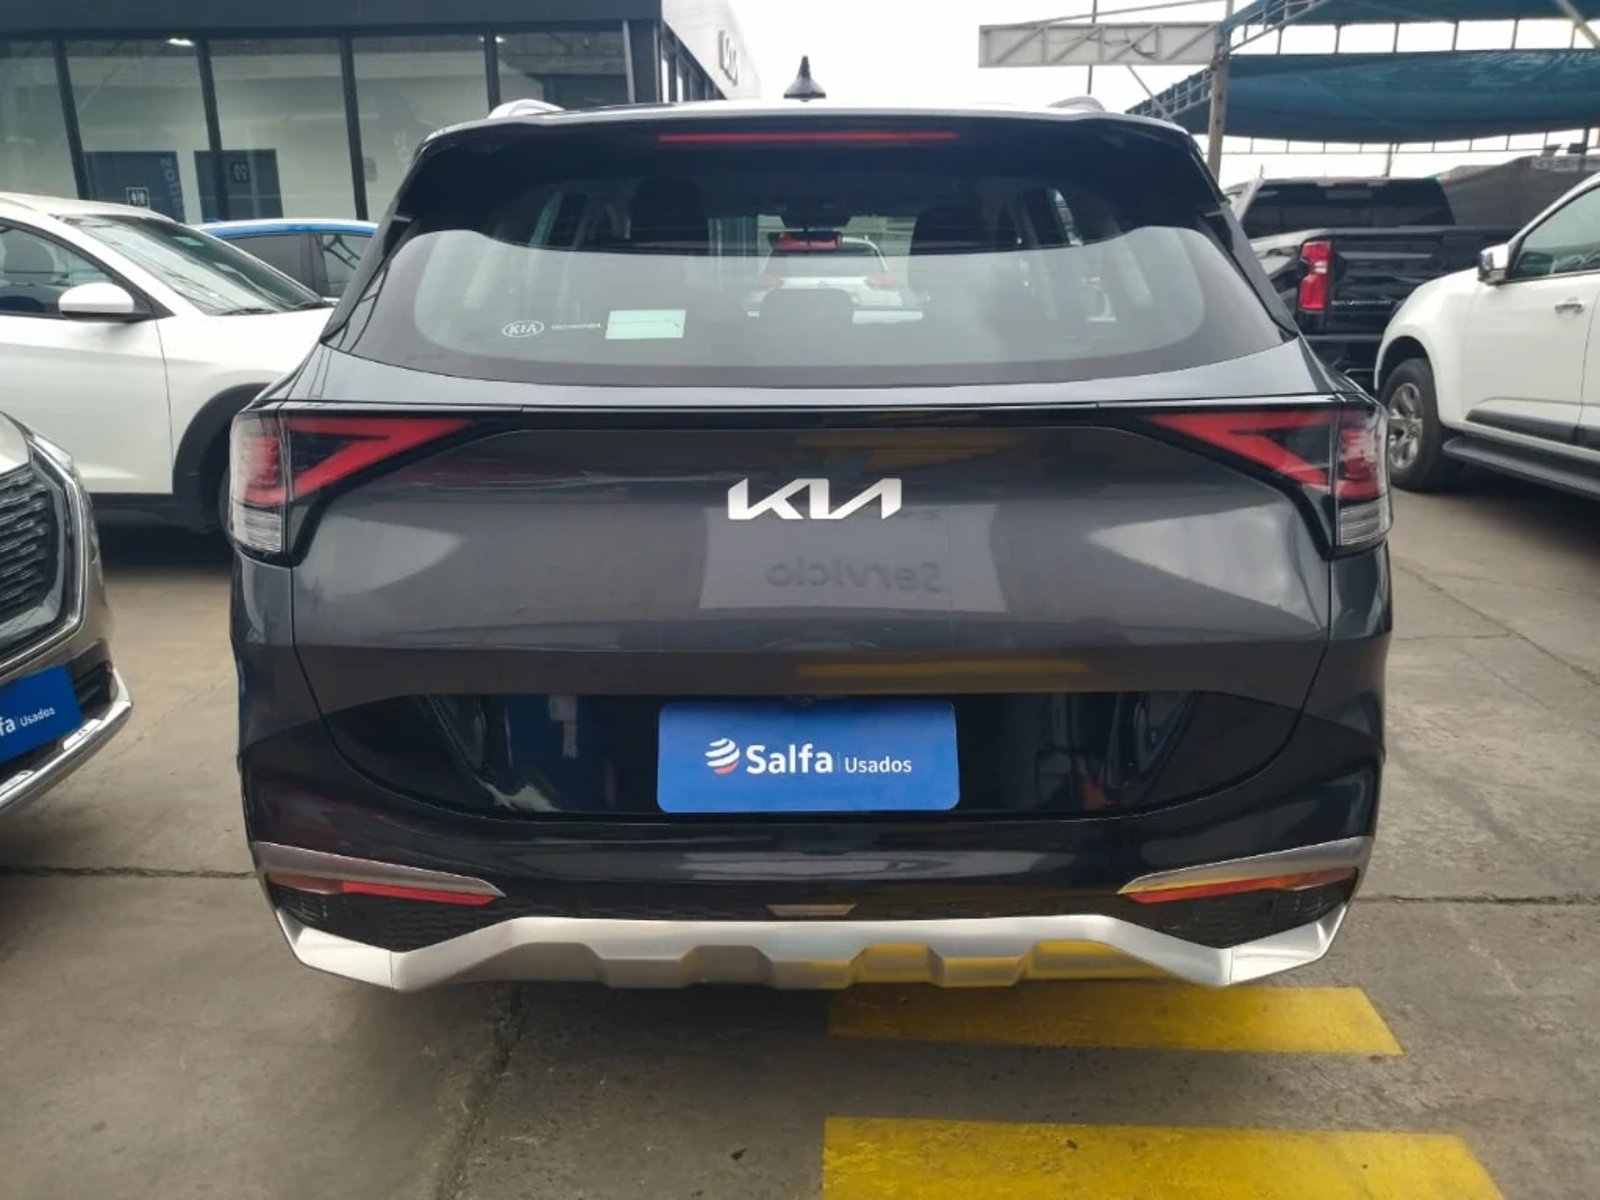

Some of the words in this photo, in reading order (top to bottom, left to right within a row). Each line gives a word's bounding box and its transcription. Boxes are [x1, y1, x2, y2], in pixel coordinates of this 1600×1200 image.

[507, 322, 539, 336] KIA
[20, 707, 56, 727] Usados
[746, 743, 833, 775] Salfa
[844, 755, 912, 774] Usados
